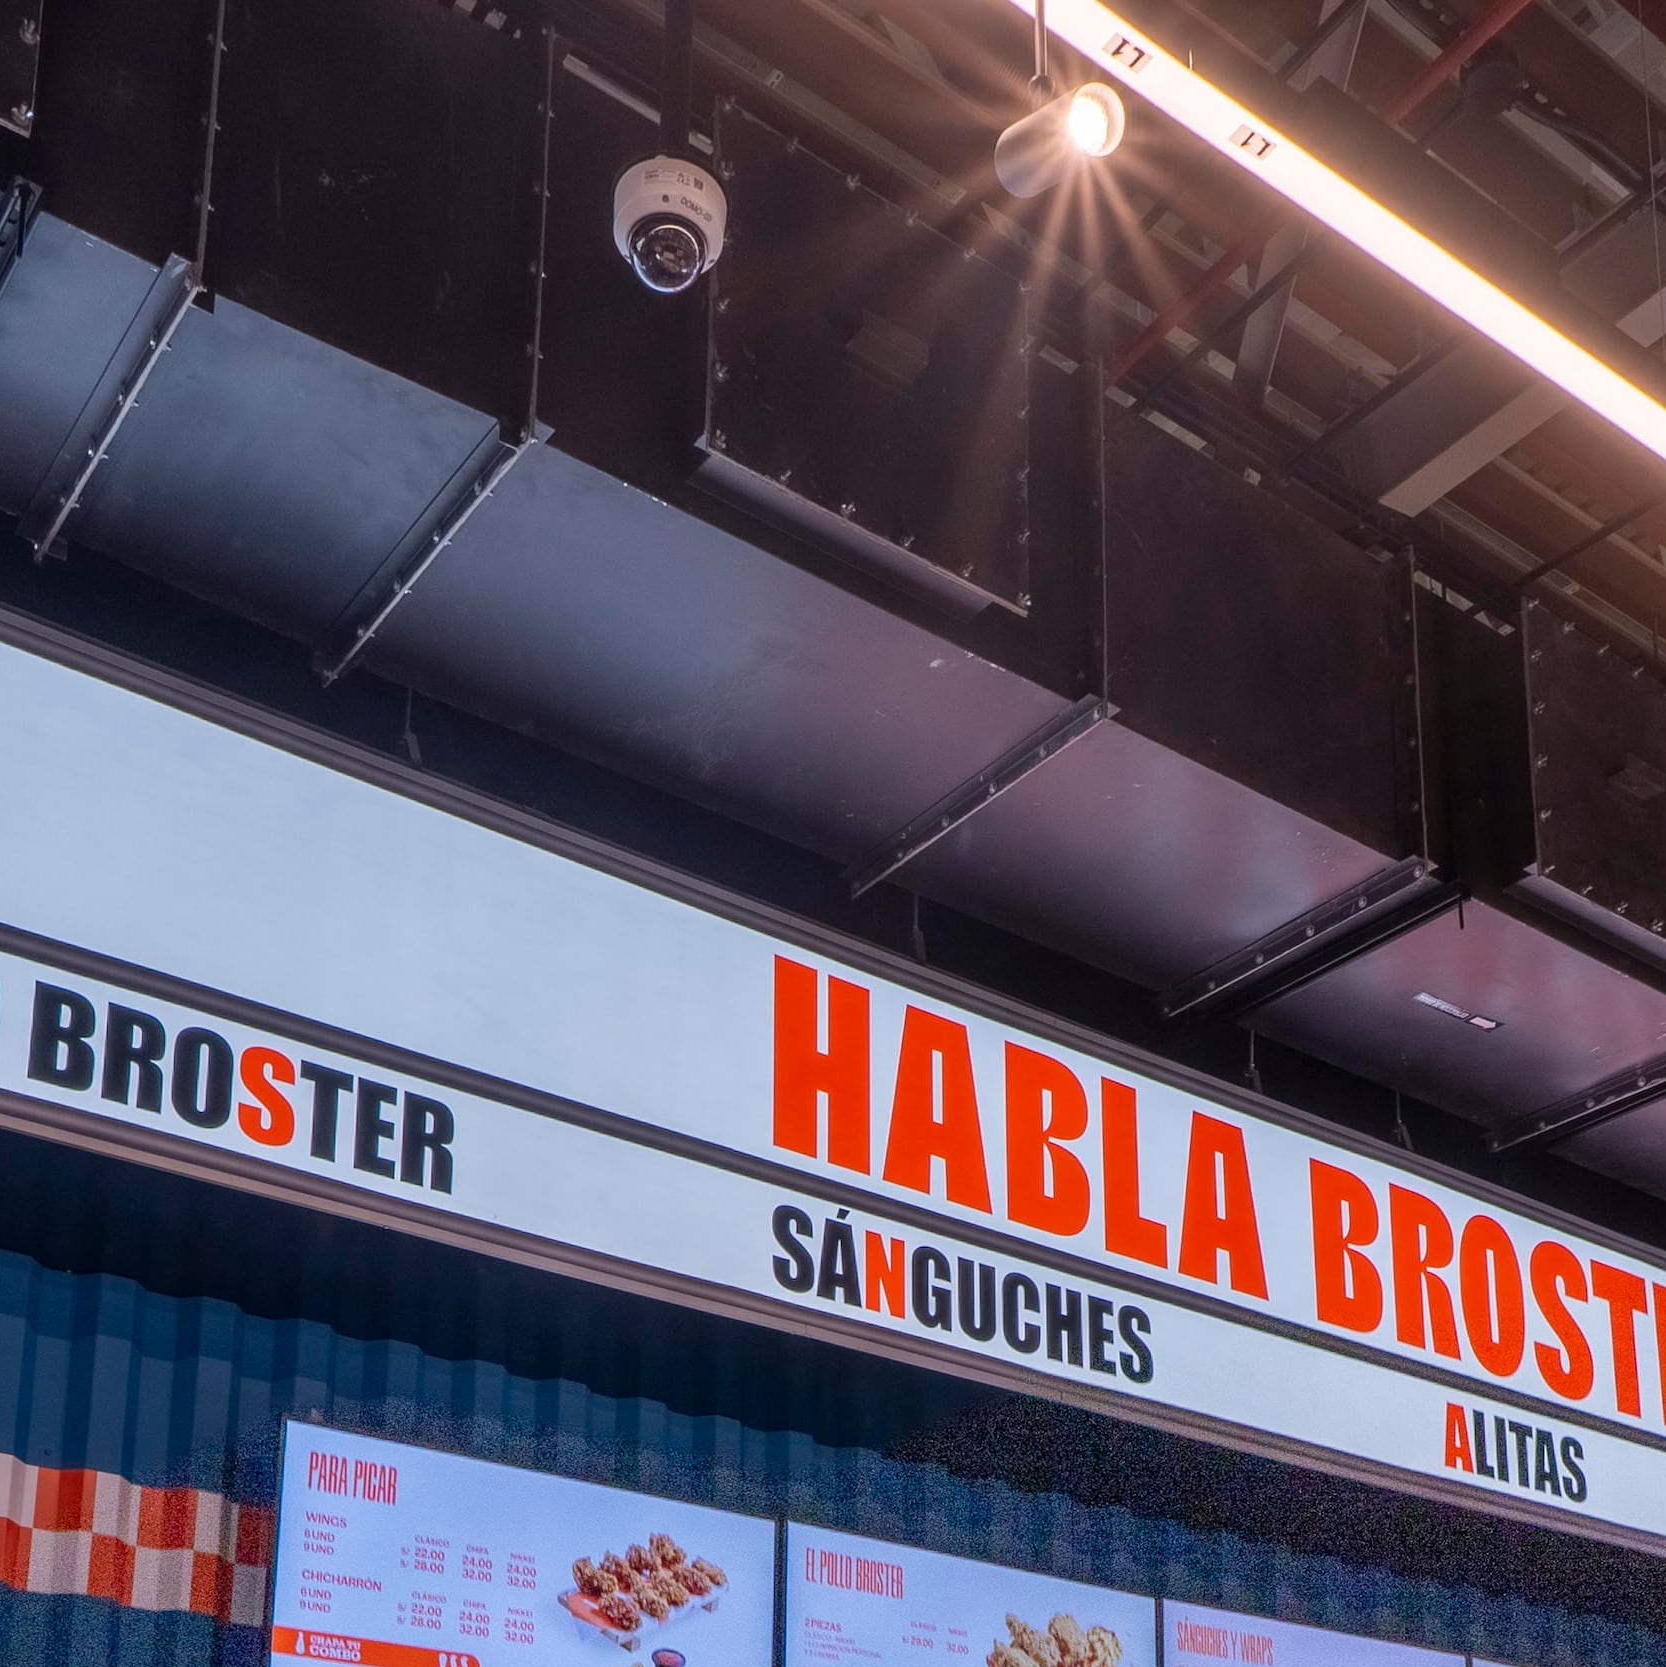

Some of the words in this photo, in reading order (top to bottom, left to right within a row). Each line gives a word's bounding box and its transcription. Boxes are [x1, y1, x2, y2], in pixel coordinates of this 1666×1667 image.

[27, 979, 455, 1195] BROSTER
[773, 952, 1269, 1302] HABLA
[771, 1205, 1155, 1386] SÁNGUCHES
[1444, 1402, 1589, 1503] ALITAS
[308, 1451, 348, 1497] PARA
[353, 1458, 398, 1507] PICAR
[305, 1511, 348, 1529] WINGS
[301, 1568, 382, 1593] CHICHARRÓN
[413, 1561, 445, 1574] 28.00
[462, 1569, 492, 1583] 32.00
[507, 1577, 536, 1591] 32.00
[414, 1548, 446, 1562] 22.00
[462, 1554, 493, 1570] 24.00
[506, 1564, 537, 1578] 24.00
[805, 1547, 816, 1583] EL
[819, 1550, 852, 1591] POLLO
[855, 1558, 904, 1600] BROSTER
[410, 1616, 442, 1630] 28.00
[459, 1623, 490, 1638] 32.00
[504, 1631, 534, 1645] 32.00
[411, 1604, 442, 1617] 22.00
[459, 1611, 490, 1625] 24.00
[504, 1617, 535, 1632] 24.00
[309, 1645, 361, 1663] COMBO
[1177, 1616, 1228, 1660] SÁNGUCHES
[1231, 1630, 1238, 1661] Y
[1239, 1631, 1274, 1667] WRAPS
